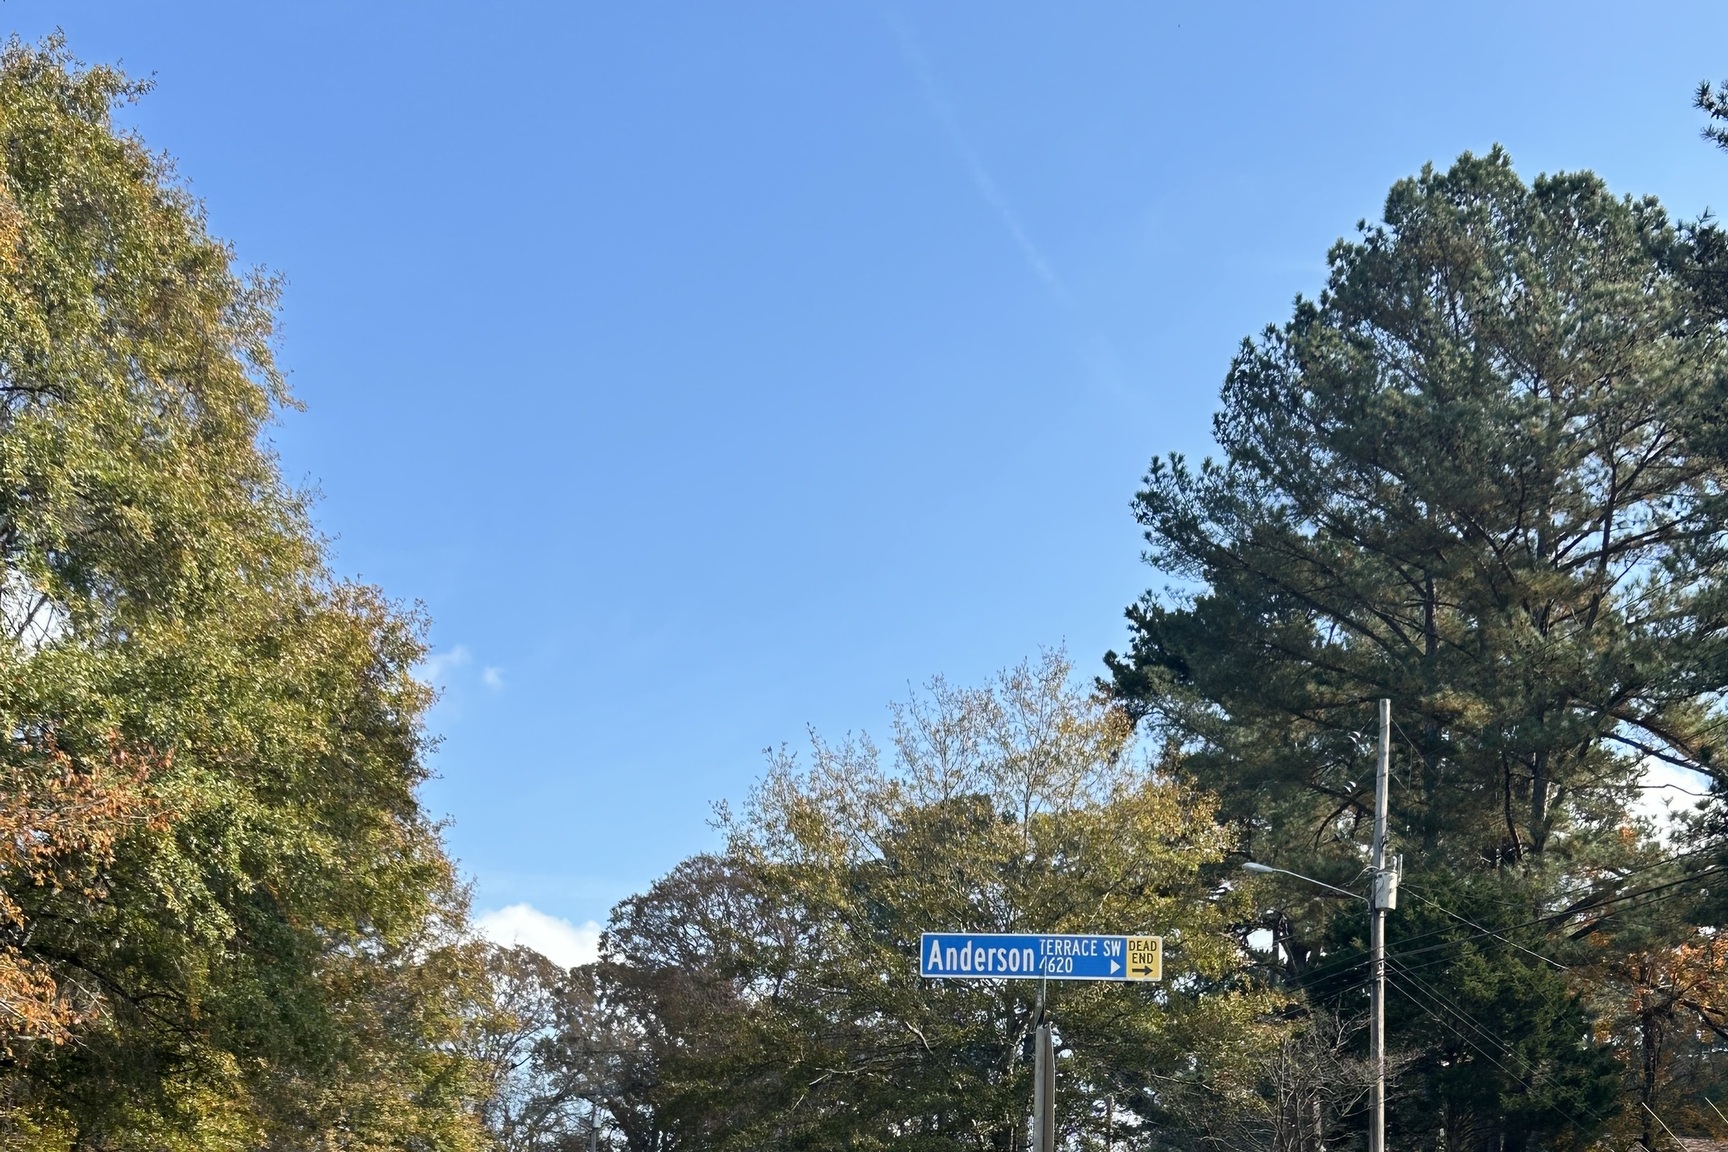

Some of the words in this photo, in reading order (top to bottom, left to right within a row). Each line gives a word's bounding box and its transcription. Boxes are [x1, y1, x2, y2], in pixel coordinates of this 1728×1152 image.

[1039, 939, 1097, 956] TERRACE
[1103, 940, 1121, 957] SW
[1129, 940, 1157, 952] DEAD
[927, 939, 1034, 972] Anderson
[1132, 952, 1153, 964] END
